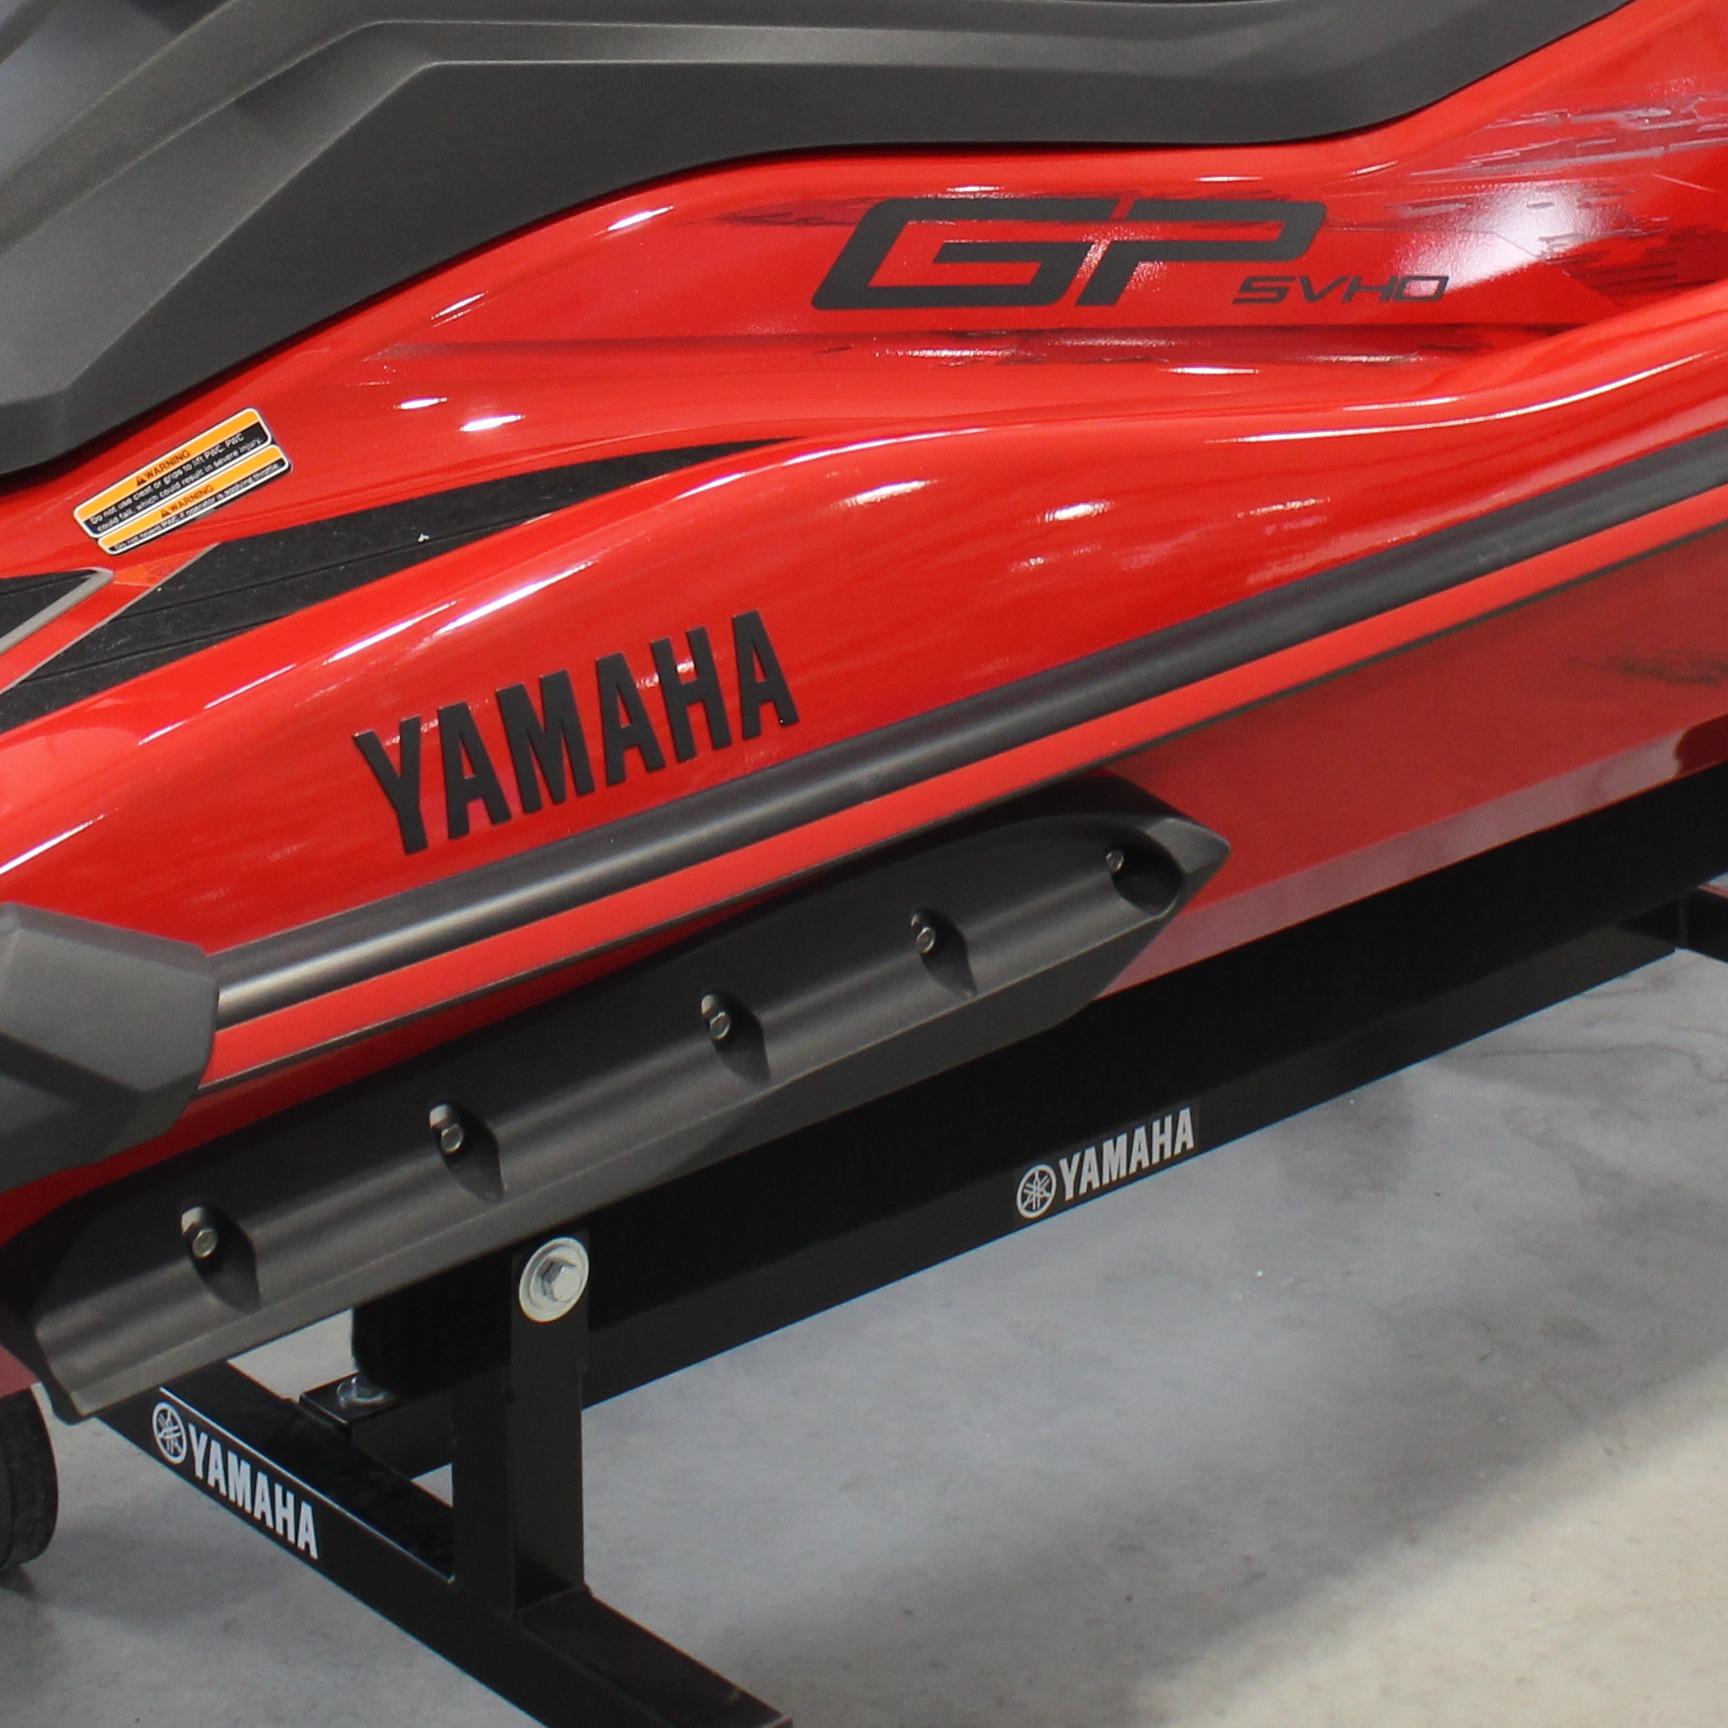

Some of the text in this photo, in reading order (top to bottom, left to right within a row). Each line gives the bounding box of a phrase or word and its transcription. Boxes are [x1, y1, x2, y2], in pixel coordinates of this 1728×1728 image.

[812, 198, 1450, 311] GP SVHO
[144, 449, 190, 479] WARNING
[169, 484, 213, 513] WARNING
[352, 609, 800, 855] YAMAHA
[1059, 1107, 1194, 1201] YAMAHA
[188, 1423, 318, 1559] YAMAHA
